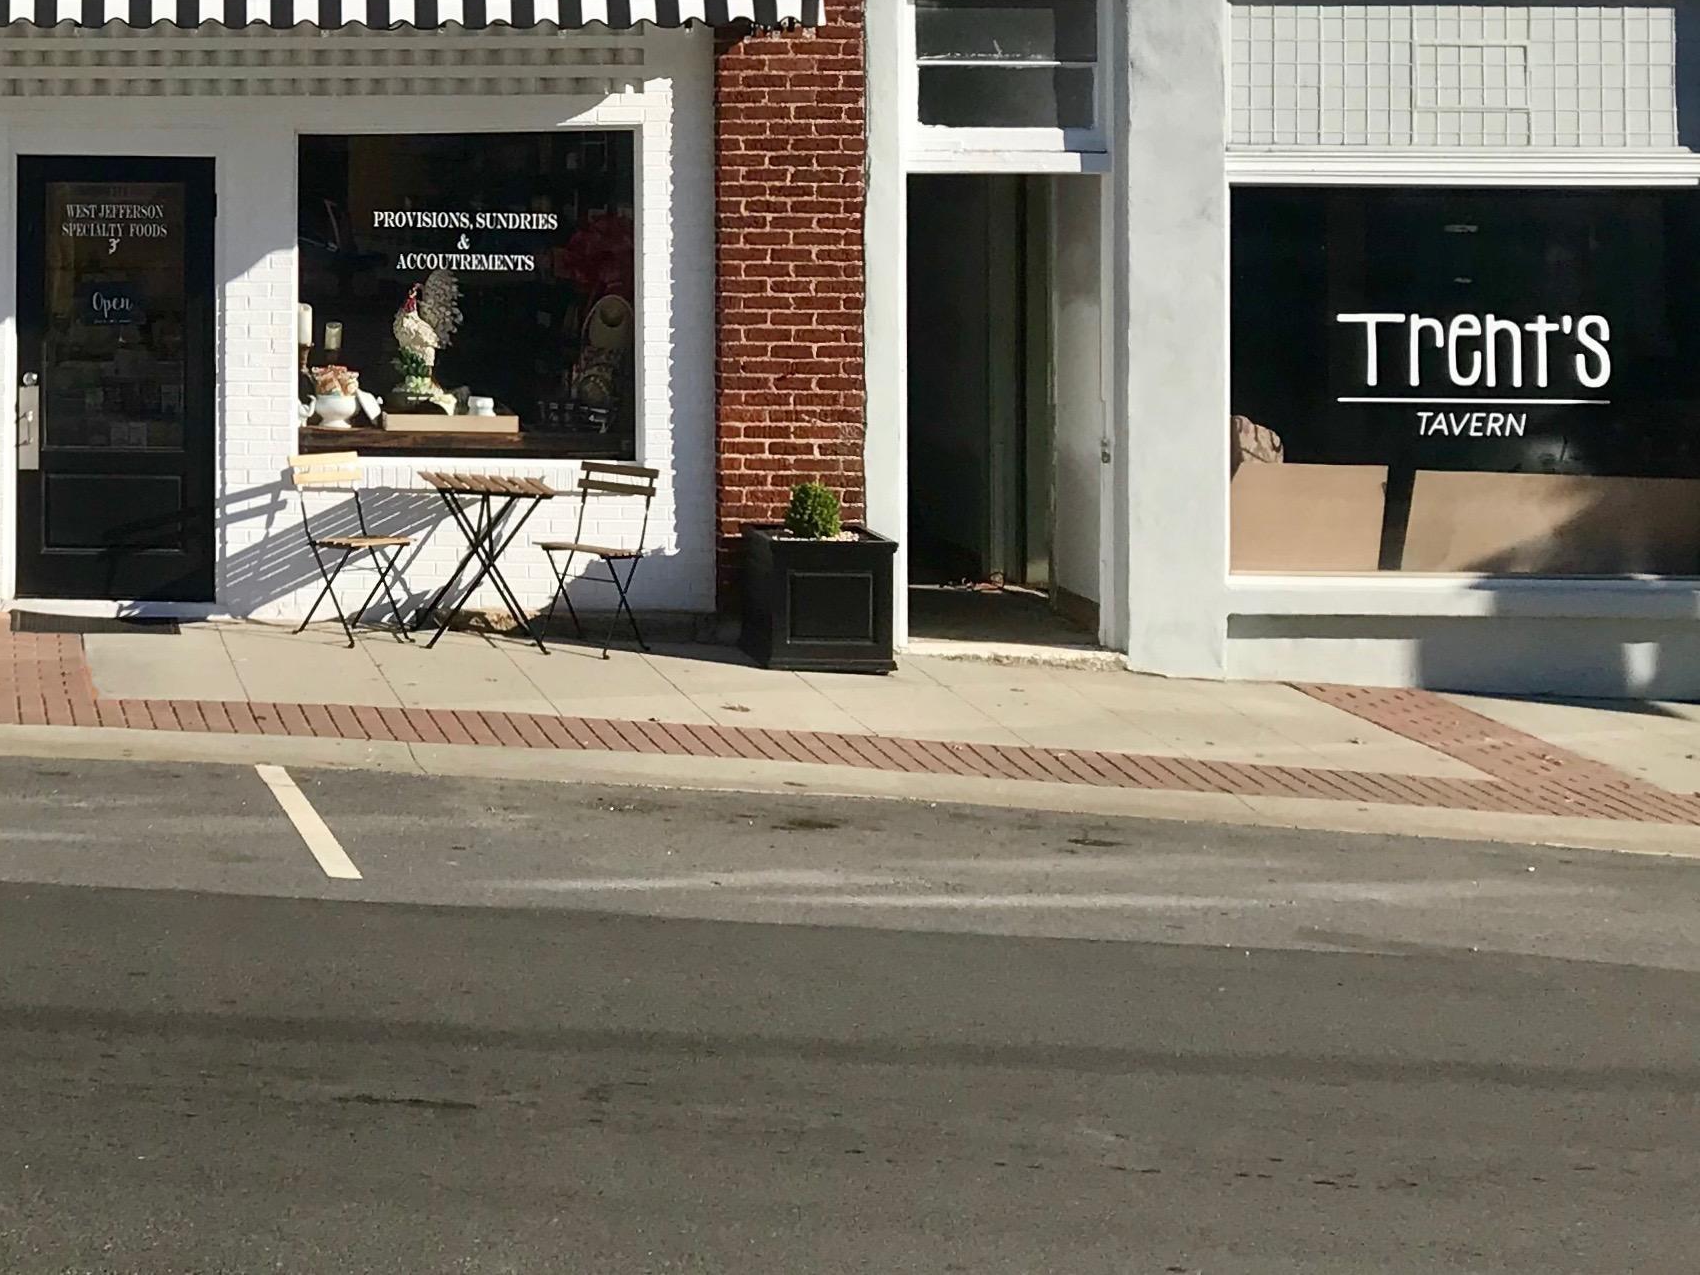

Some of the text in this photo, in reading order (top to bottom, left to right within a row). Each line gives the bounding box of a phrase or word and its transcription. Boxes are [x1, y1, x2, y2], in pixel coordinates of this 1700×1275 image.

[66, 204, 164, 219] WEST JEFFERSON
[373, 211, 558, 230] PROVISIONS, SUNDRIES
[61, 223, 168, 237] SPECIALTY FOODS
[456, 233, 470, 249] &
[396, 253, 535, 272] ACCOUTREMENTS
[92, 291, 133, 318] Open
[1336, 313, 1611, 388] Trent's
[1416, 411, 1528, 437] TAVERN
